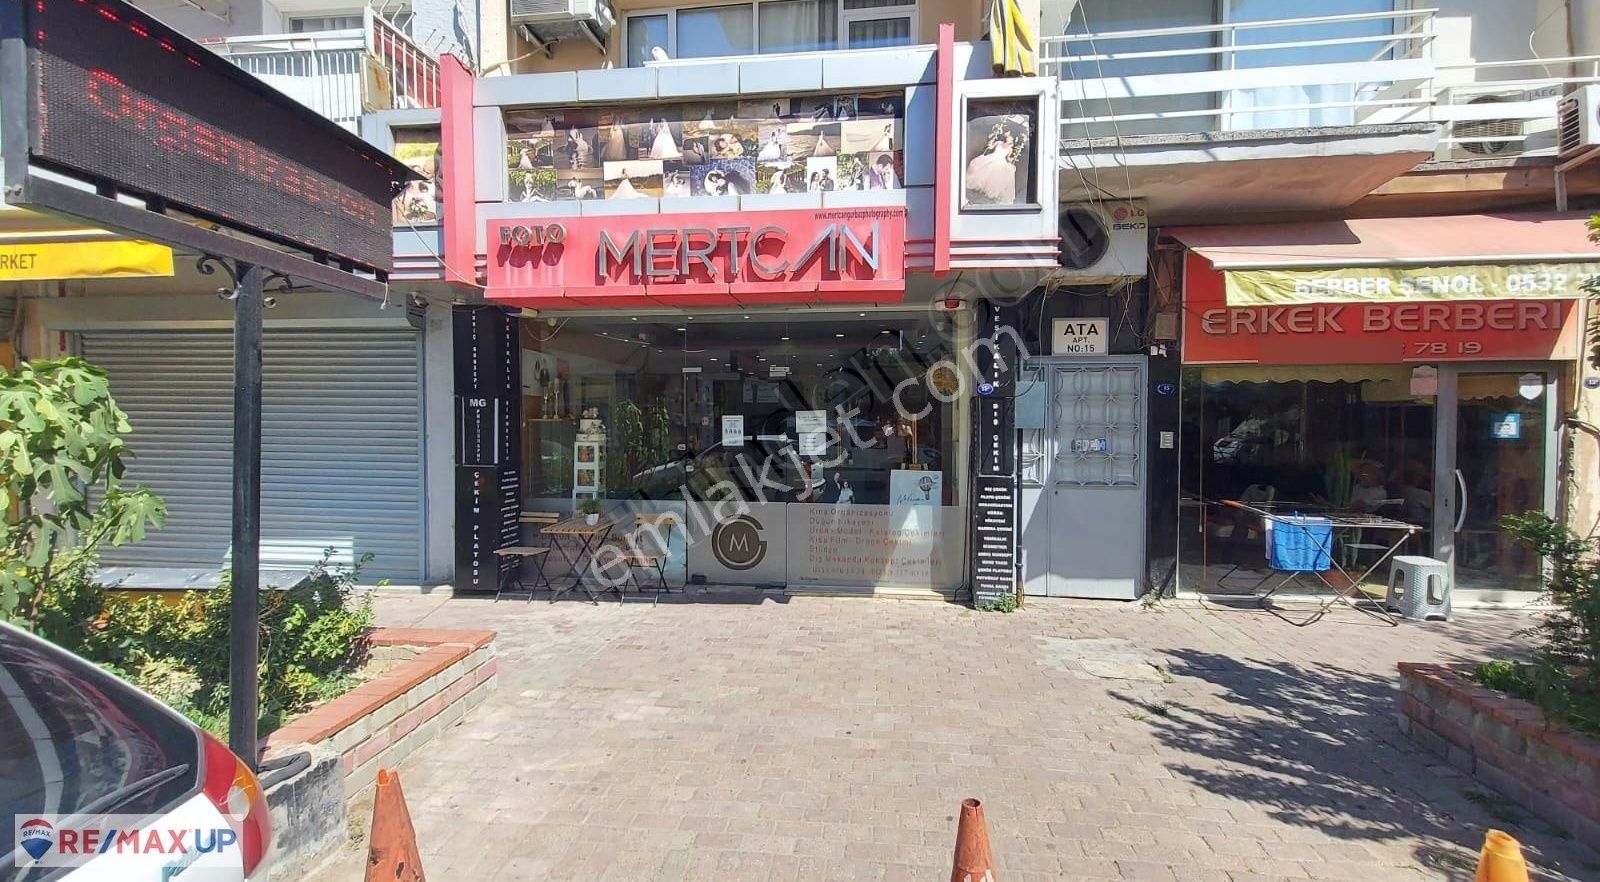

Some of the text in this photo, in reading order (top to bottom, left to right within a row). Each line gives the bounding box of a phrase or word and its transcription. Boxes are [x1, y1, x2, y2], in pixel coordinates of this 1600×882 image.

[1130, 209, 1145, 217] LG
[500, 220, 881, 278] FOTO MERTCAN
[0, 253, 37, 269] RKET
[1294, 278, 1393, 297] BERBER
[1506, 274, 1569, 292] 0532
[1201, 306, 1345, 335] ERKEK
[1063, 324, 1099, 336] ATA
[1067, 344, 1095, 353] NO:15
[1415, 342, 1483, 354] 78 19
[469, 399, 487, 407] MG
